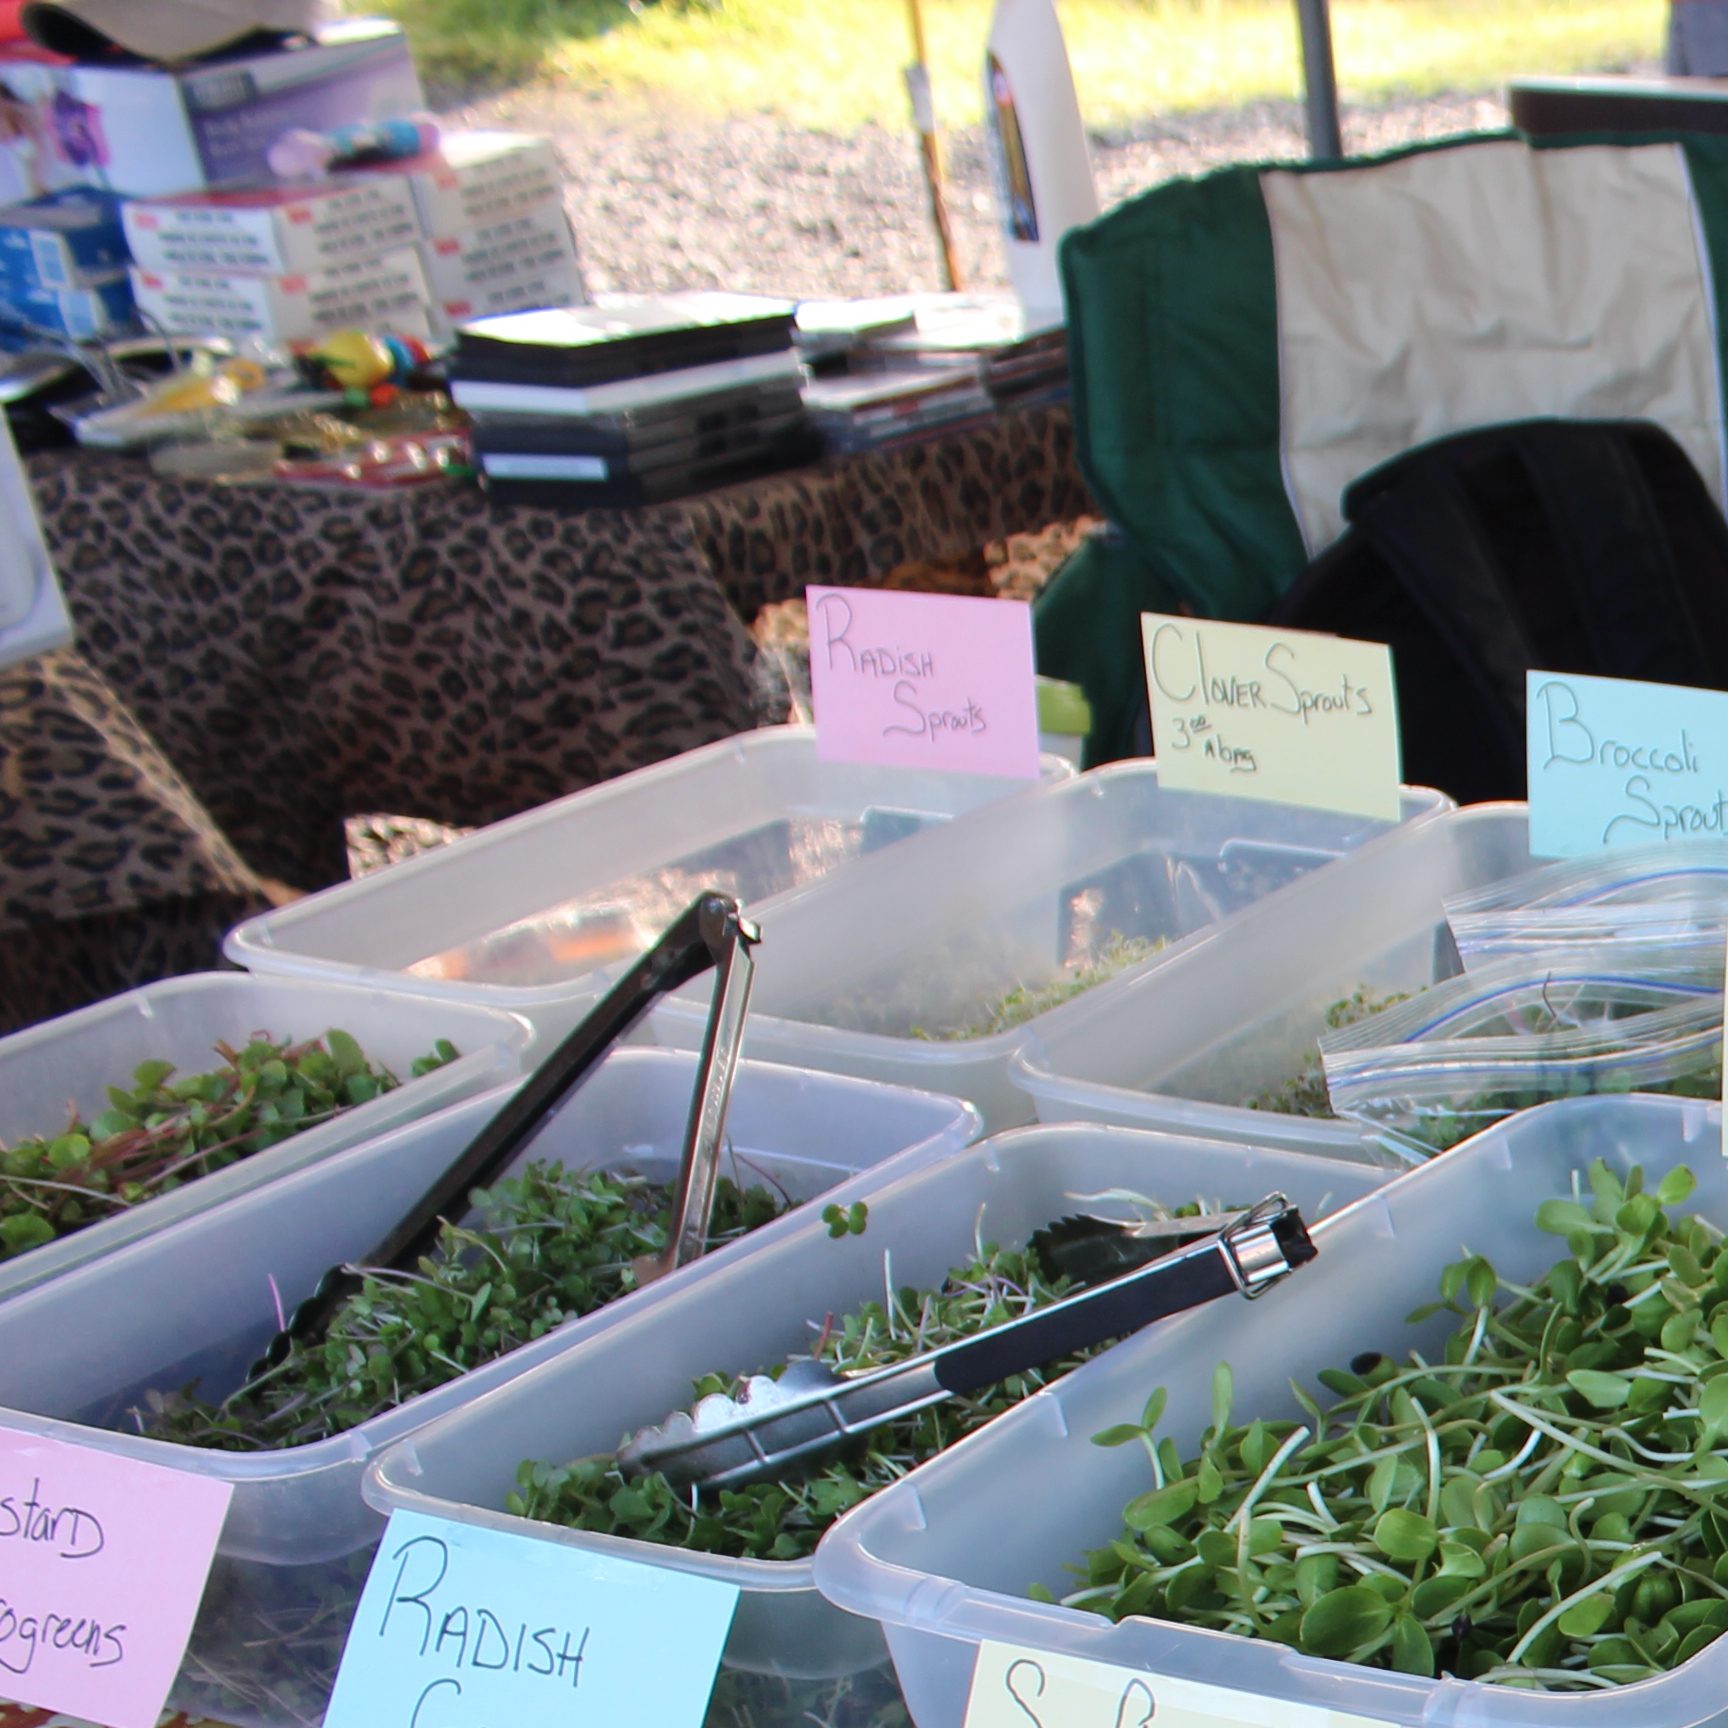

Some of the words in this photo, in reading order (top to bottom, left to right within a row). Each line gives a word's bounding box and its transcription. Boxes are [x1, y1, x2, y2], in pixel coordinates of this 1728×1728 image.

[883, 680, 987, 744] Sprouts
[1264, 642, 1373, 725] Sprouts
[1536, 681, 1699, 773] Broccoli
[378, 1535, 591, 1689] RADISH
